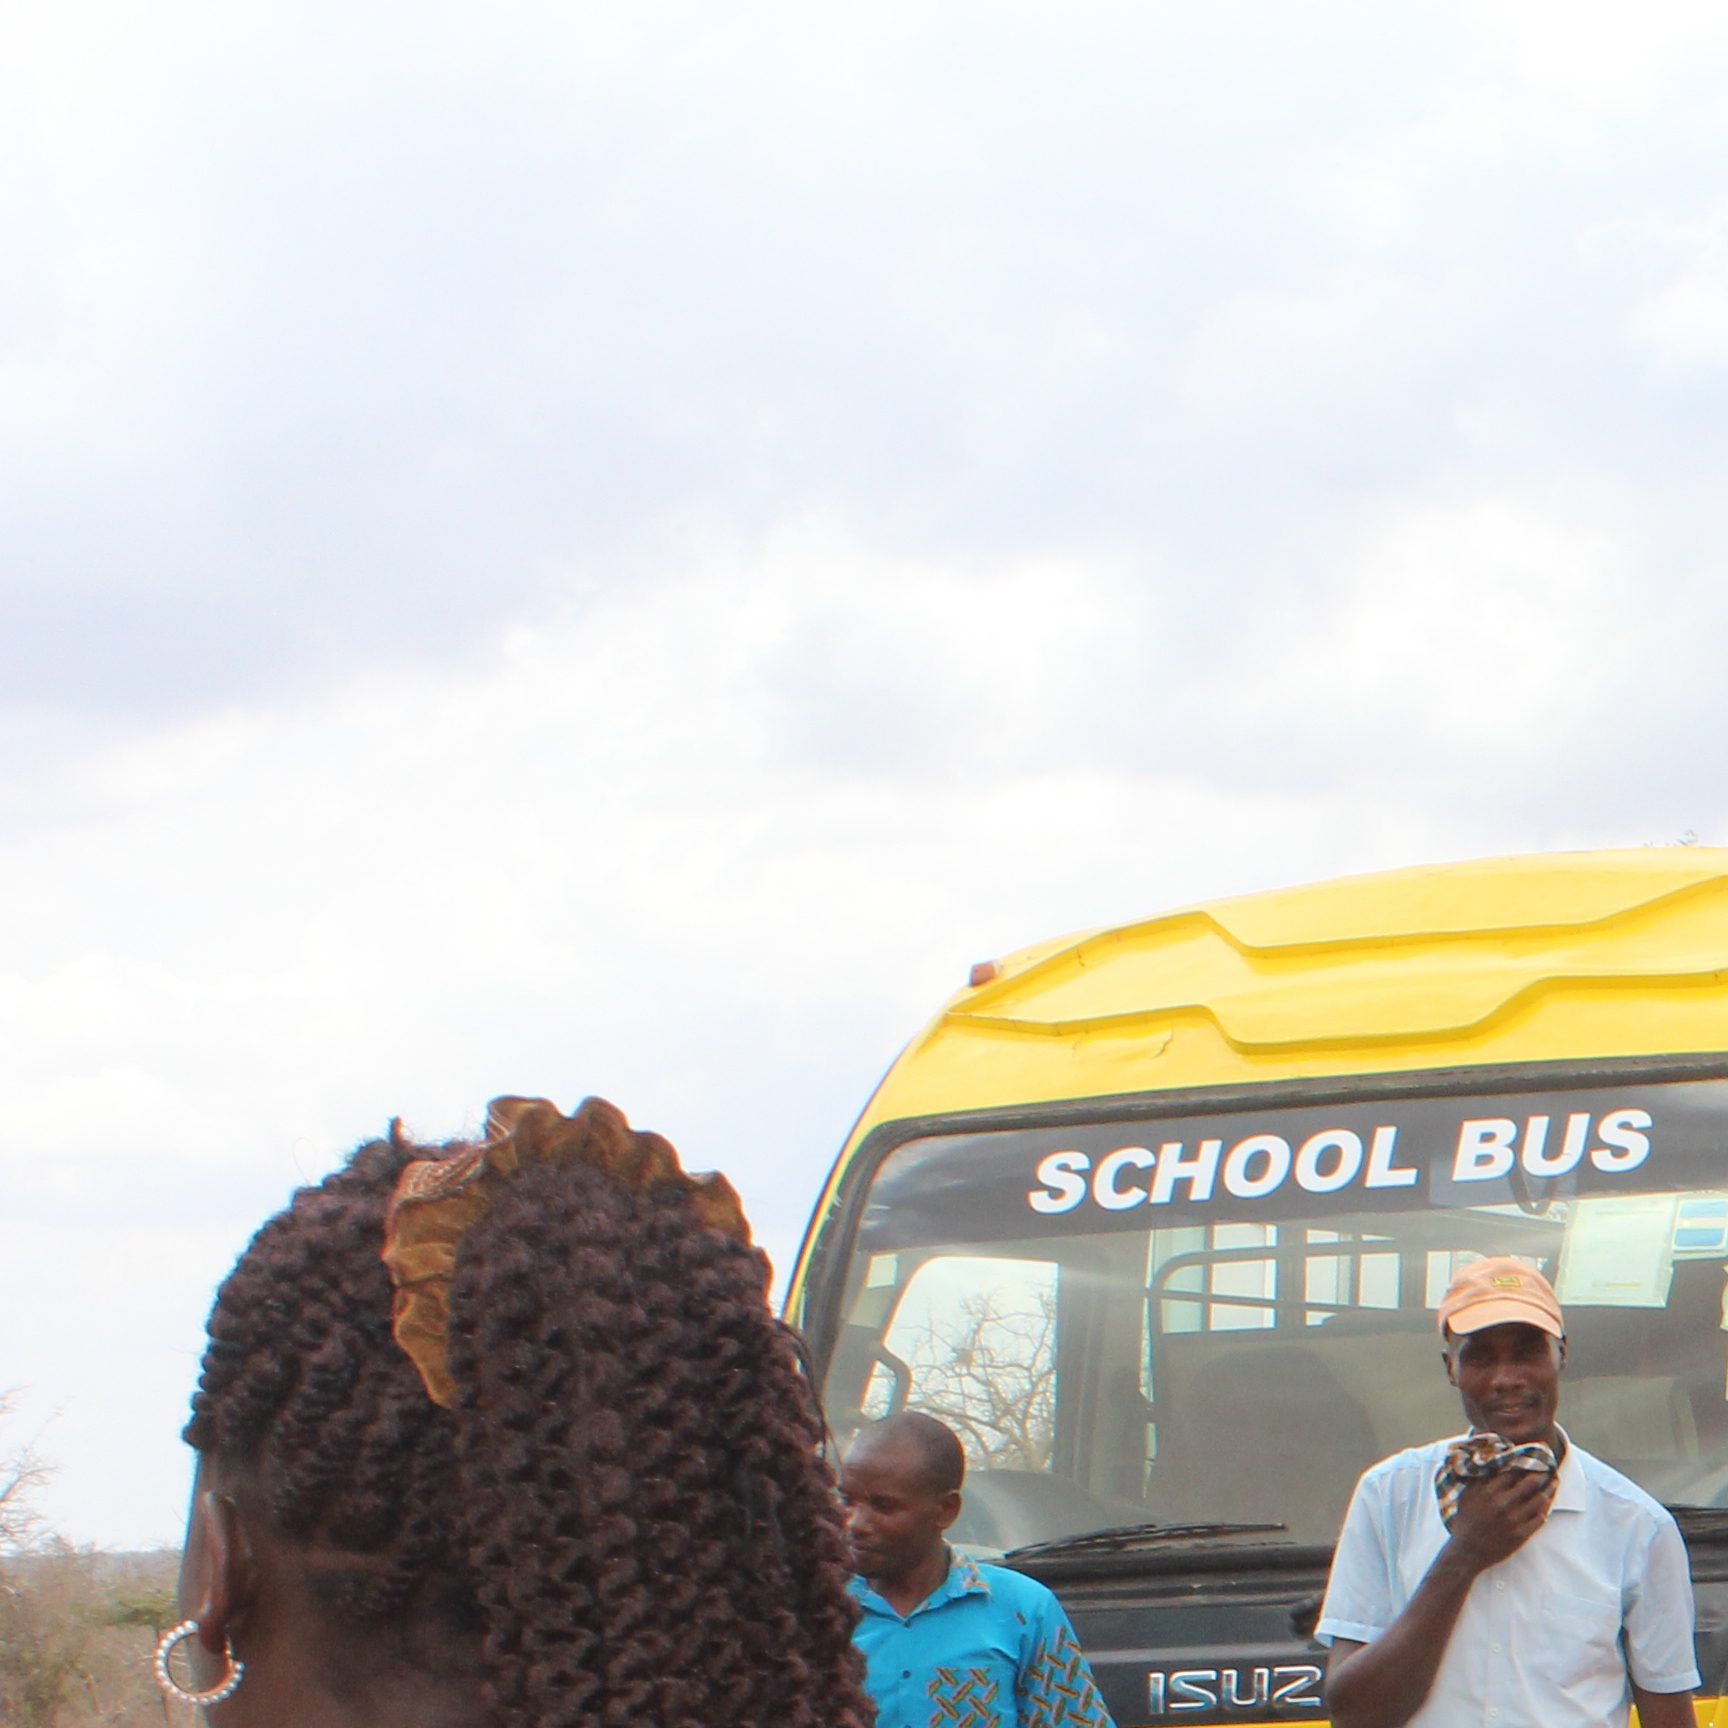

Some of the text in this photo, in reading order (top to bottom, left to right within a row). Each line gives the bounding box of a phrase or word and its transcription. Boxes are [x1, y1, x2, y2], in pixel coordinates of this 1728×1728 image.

[1027, 1109, 1654, 1214] SCHOOL BUS
[1148, 1664, 1322, 1715] ISUZ
